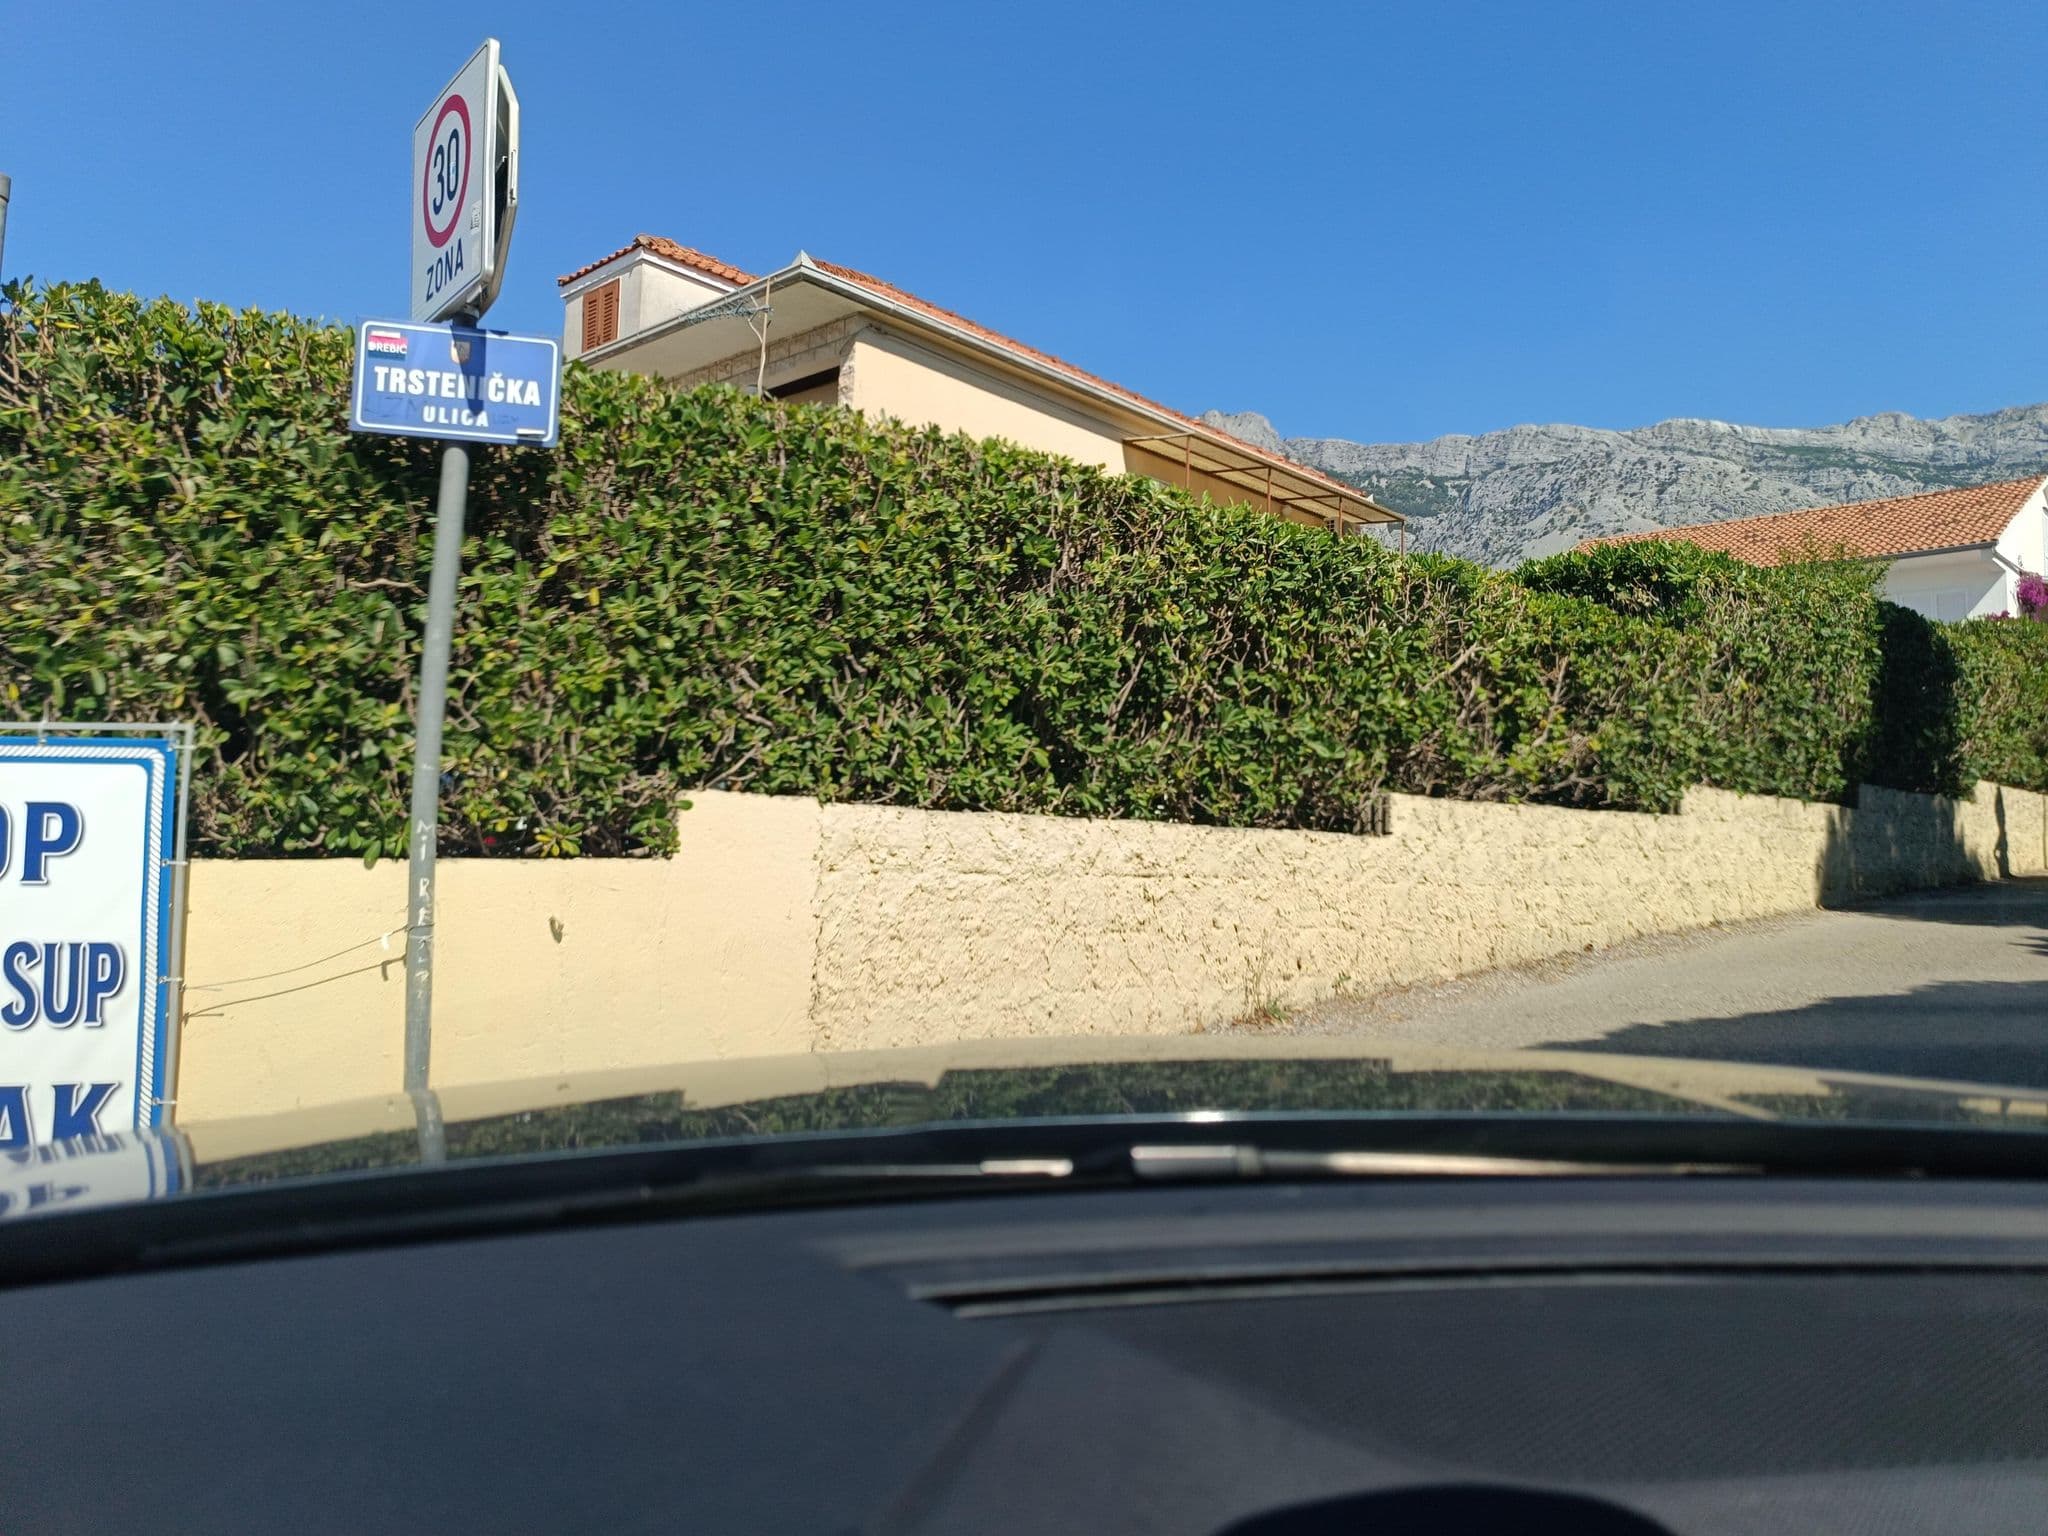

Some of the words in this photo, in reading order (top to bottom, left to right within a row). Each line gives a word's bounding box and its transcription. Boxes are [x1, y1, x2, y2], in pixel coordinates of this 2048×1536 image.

[432, 127, 460, 216] 30
[425, 237, 465, 302] ZONA
[374, 365, 541, 407] TRSTENIČKA
[422, 405, 489, 427] ULICA
[0, 801, 82, 884] P
[0, 940, 124, 1028] SUP
